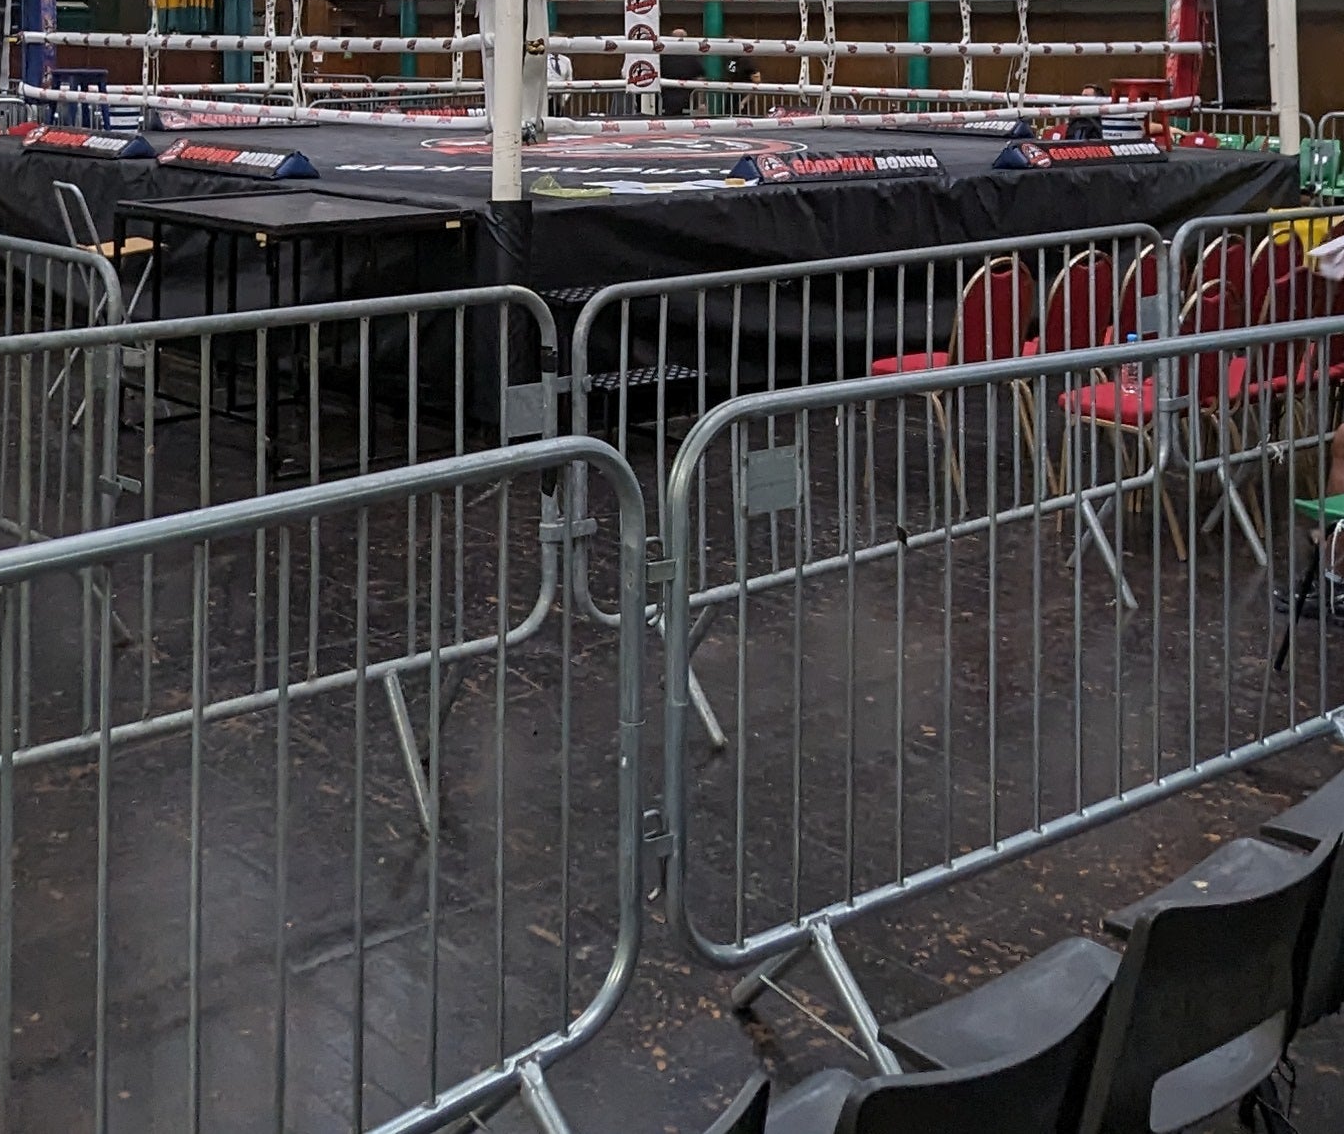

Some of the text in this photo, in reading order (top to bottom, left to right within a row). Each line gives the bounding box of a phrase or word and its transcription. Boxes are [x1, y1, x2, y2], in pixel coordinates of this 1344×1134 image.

[1048, 145, 1113, 161] GOODWIN
[1110, 143, 1161, 157] BOXING
[792, 154, 875, 176] GOODWIN
[876, 154, 938, 170] BOXING
